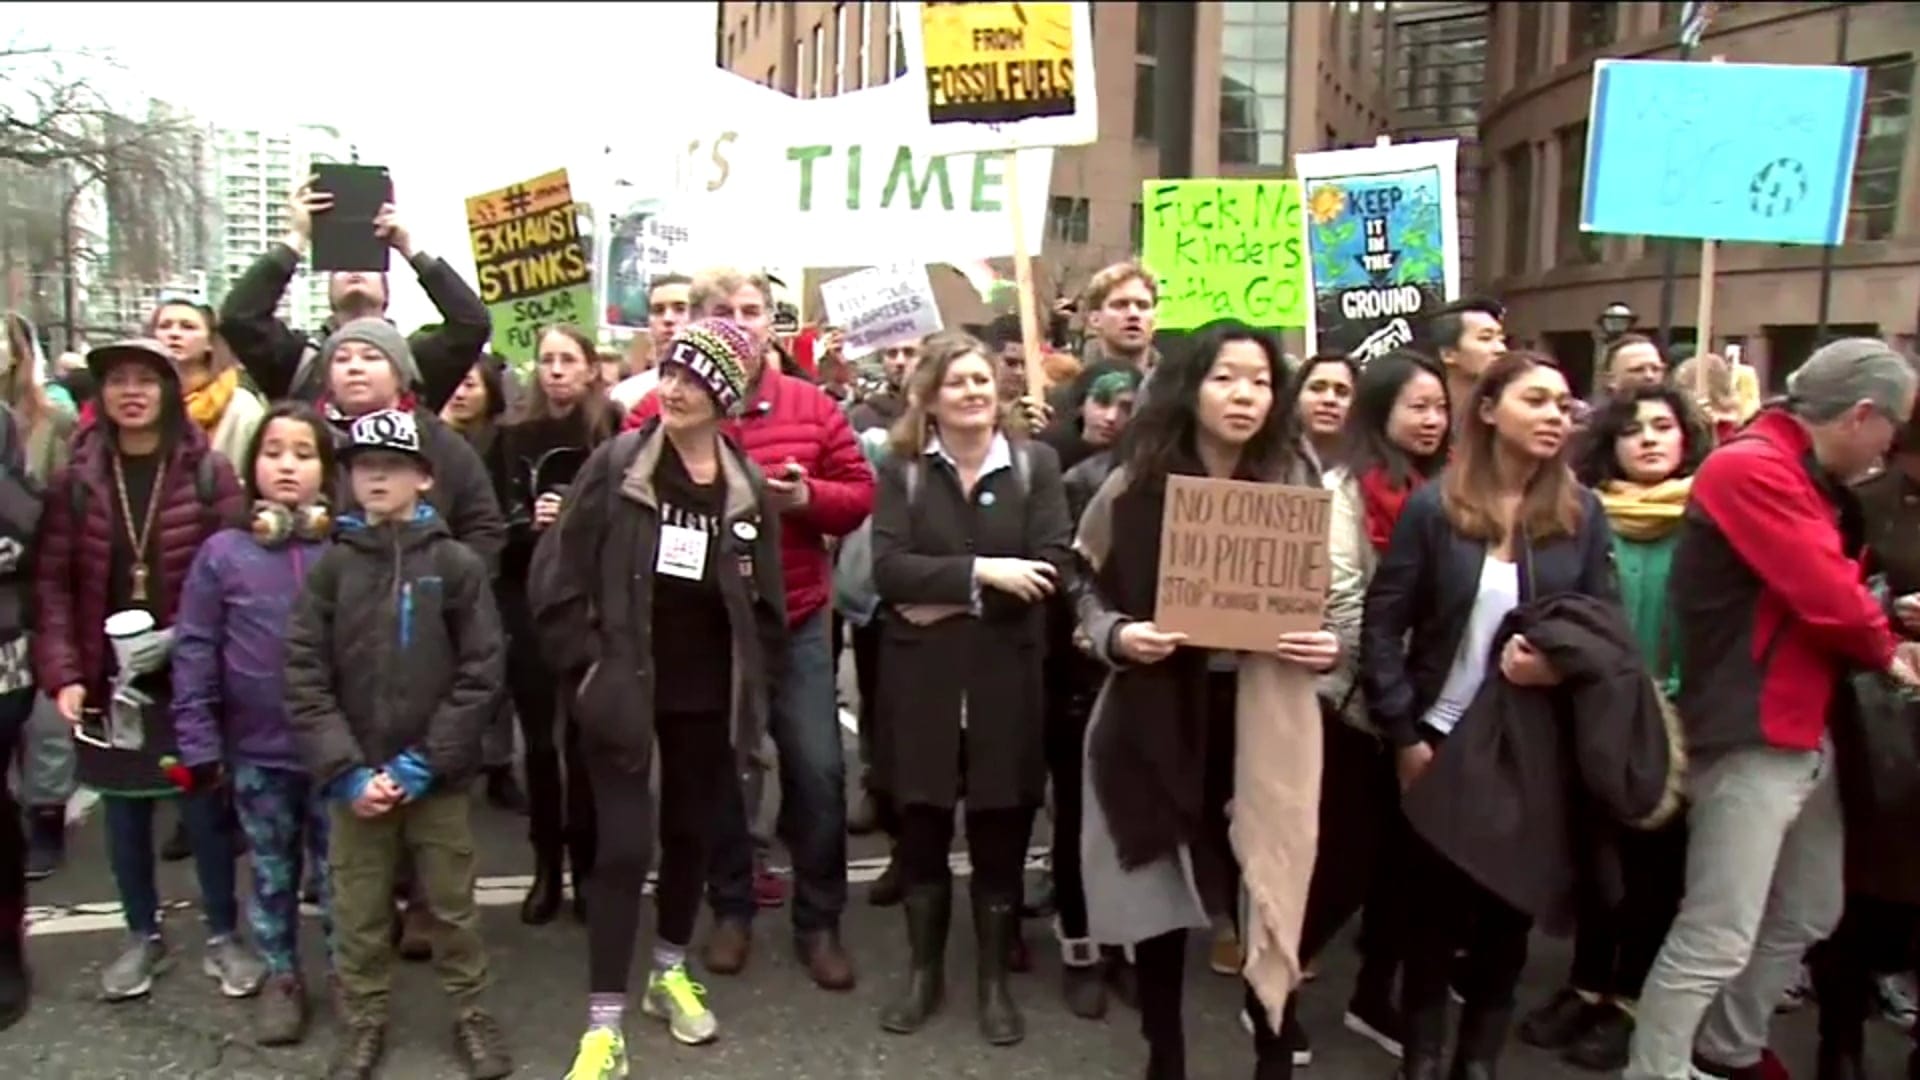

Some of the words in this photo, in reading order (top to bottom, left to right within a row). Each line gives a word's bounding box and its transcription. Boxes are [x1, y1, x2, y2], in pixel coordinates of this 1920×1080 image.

[973, 28, 1024, 51] FROM
[927, 62, 1004, 104] FOSSIL
[1005, 58, 1073, 101] FUELS
[786, 144, 1002, 212] TIME
[1153, 185, 1241, 230] Fuck
[1348, 186, 1402, 215] KEEP
[471, 204, 577, 260] EXHAUST
[1366, 219, 1384, 235] IT
[1367, 236, 1385, 252] IN
[1174, 231, 1302, 269] Kinders
[1362, 254, 1393, 271] THE
[479, 244, 586, 302] STINKS
[513, 291, 574, 322] SOLAR
[1243, 275, 1300, 318] GO
[1342, 286, 1421, 319] GROUND
[1173, 487, 1213, 525] NO
[1222, 489, 1331, 535] CONSENT
[1169, 528, 1208, 568] NO
[1214, 533, 1323, 592] PIPELINE
[1162, 576, 1210, 607] STOP
